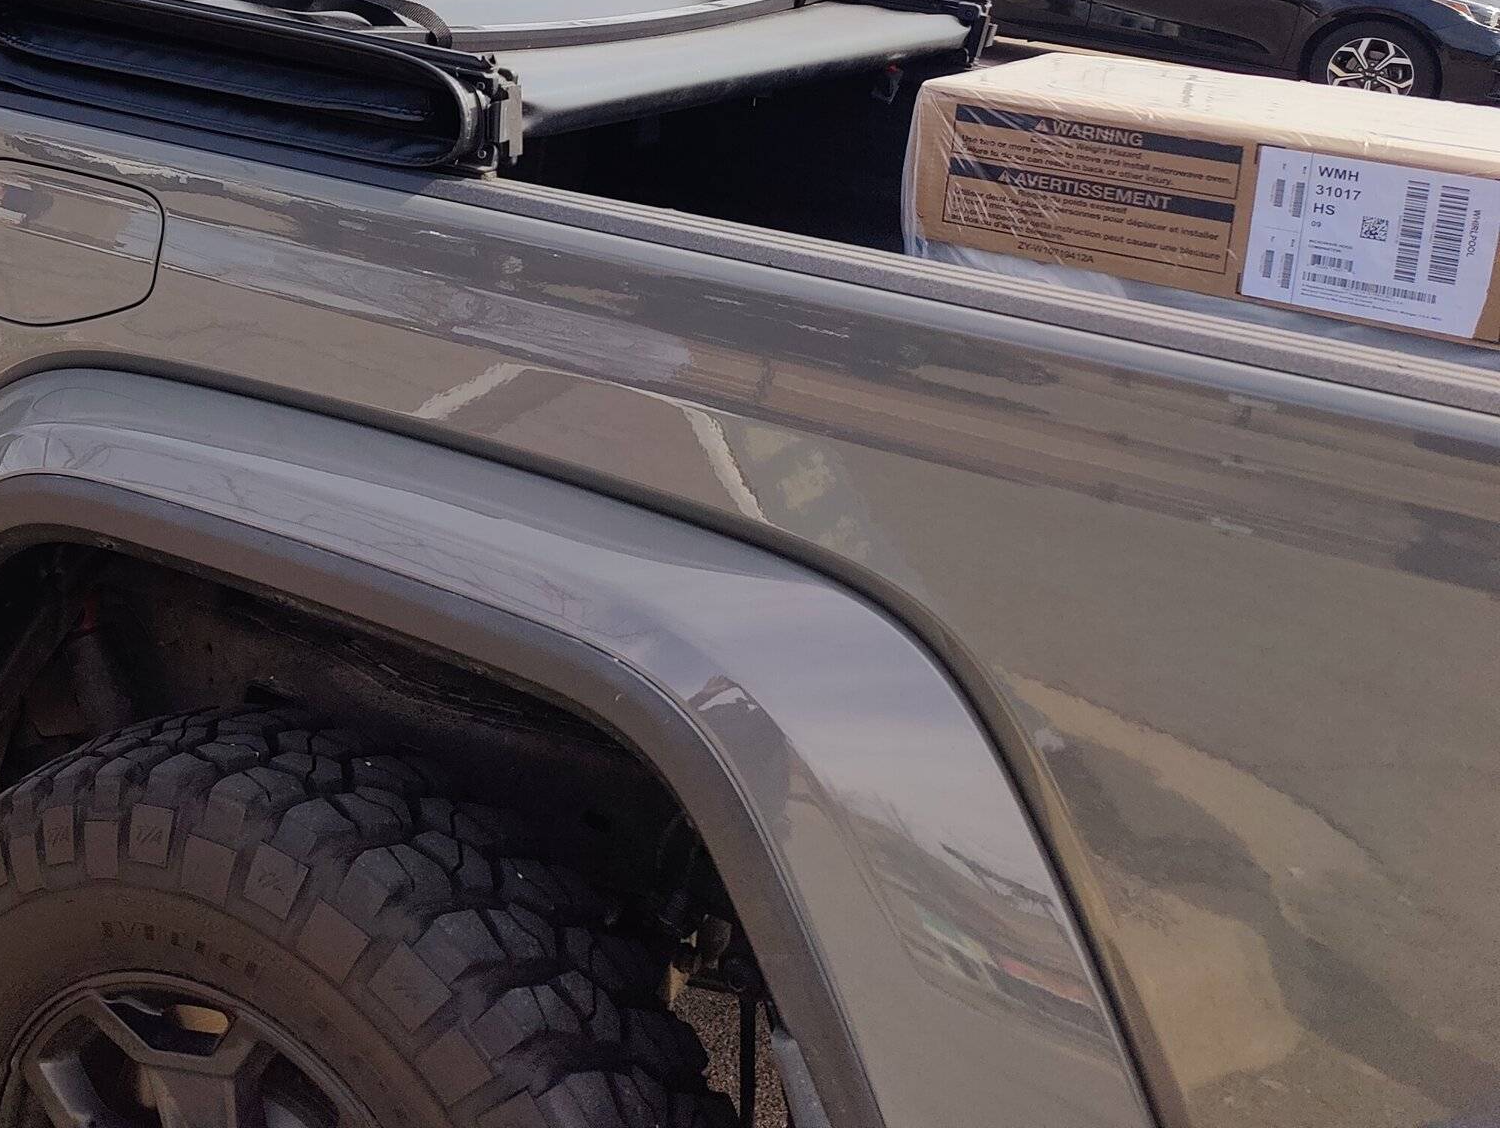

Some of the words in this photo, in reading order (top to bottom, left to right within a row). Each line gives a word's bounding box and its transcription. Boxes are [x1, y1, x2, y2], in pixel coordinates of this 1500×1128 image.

[1052, 120, 1144, 147] WARNING
[1103, 157, 1120, 166] and
[1152, 166, 1203, 180] microwave
[1318, 165, 1360, 182] WMH
[1016, 172, 1171, 209] AVERTISSEMENT
[1315, 184, 1362, 201] 31017
[1313, 202, 1336, 215] HS
[1466, 209, 1481, 257] WHIRLPOOL
